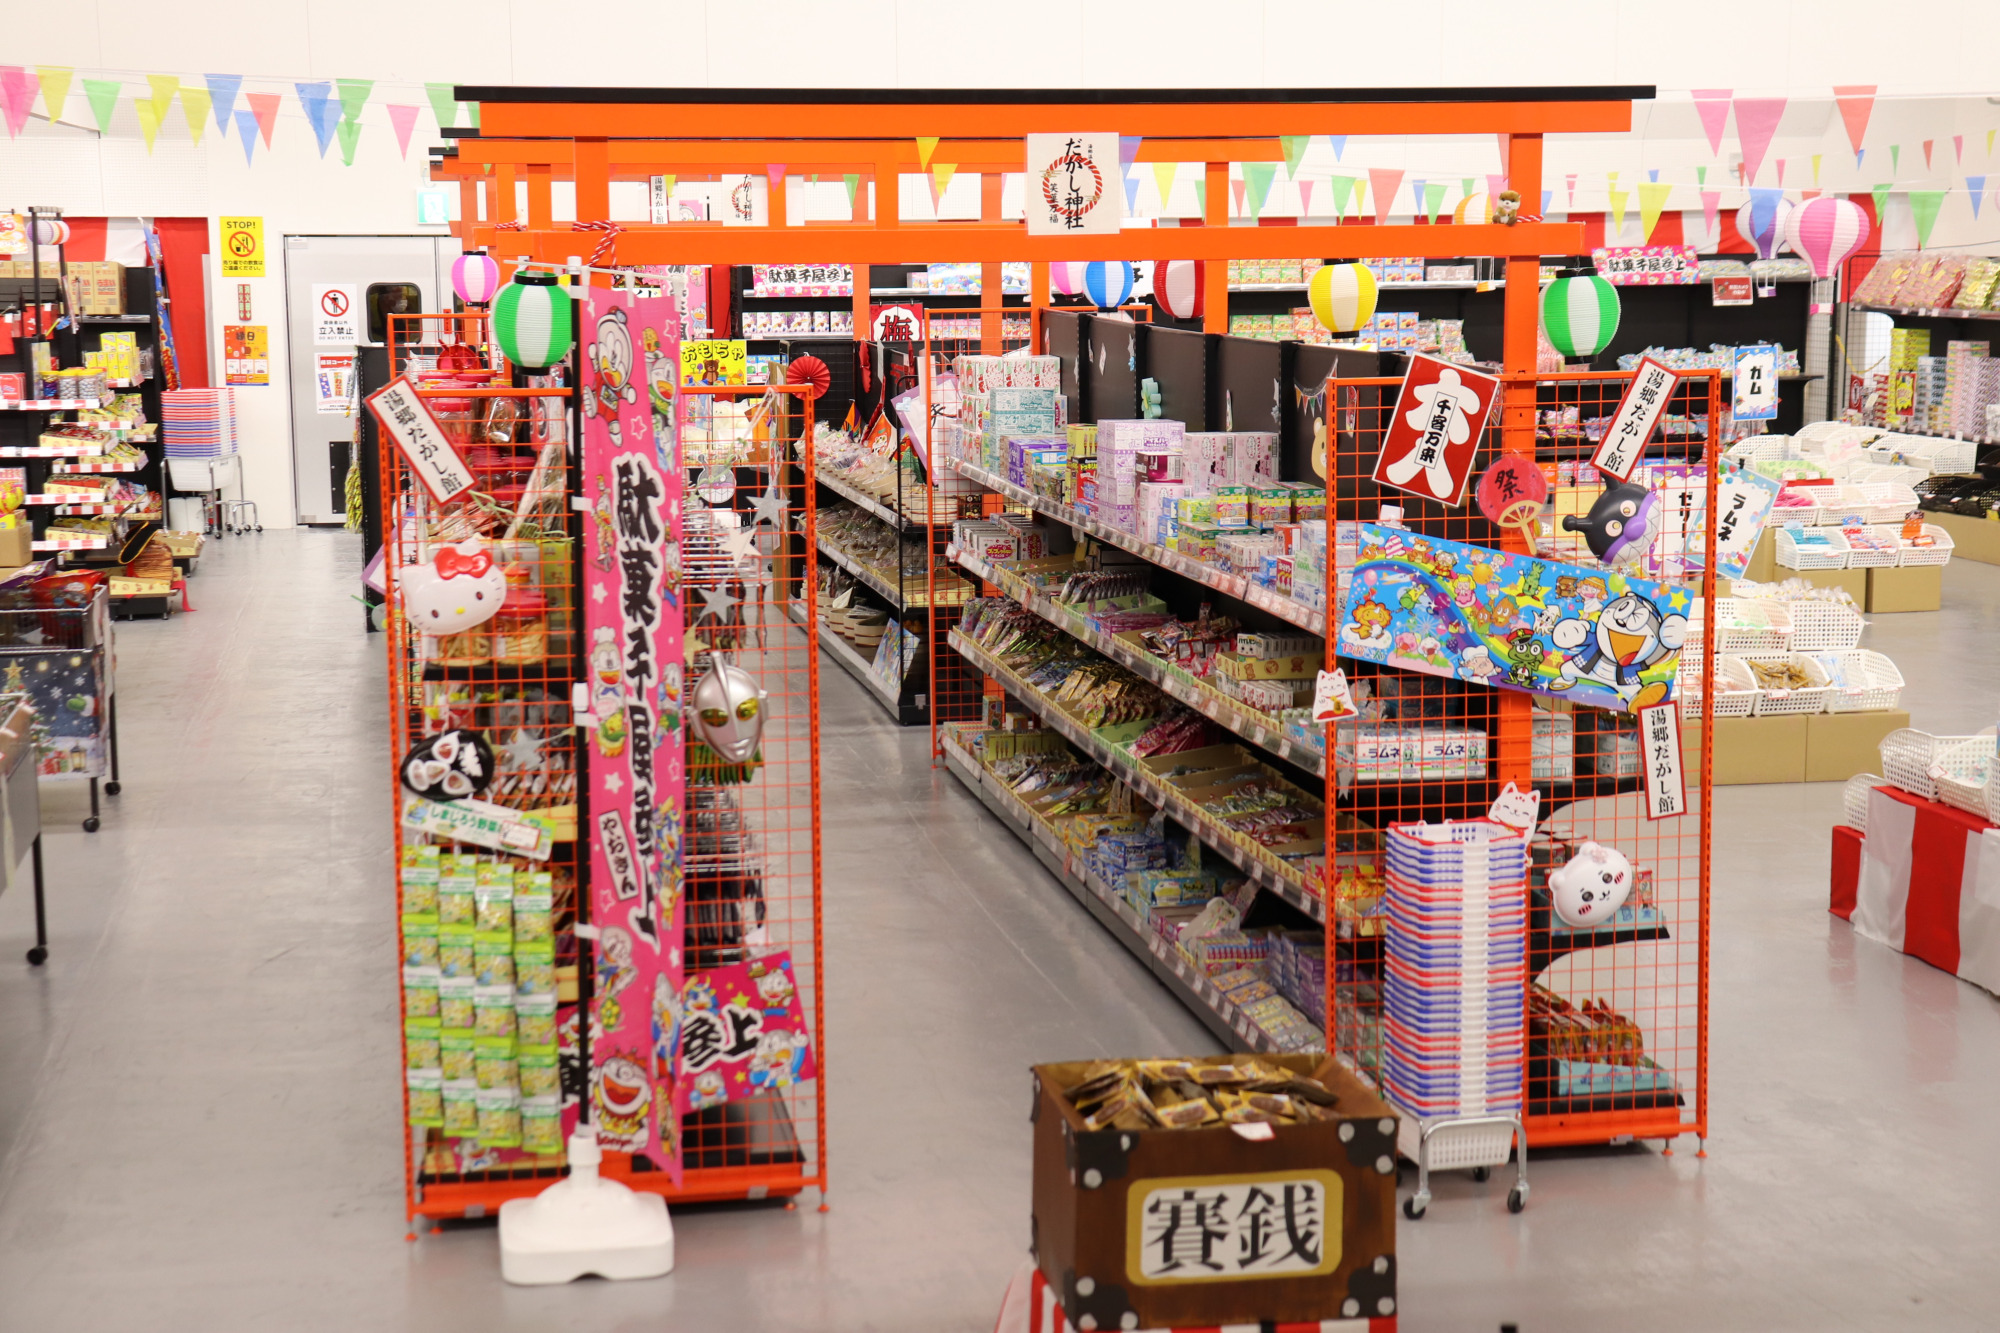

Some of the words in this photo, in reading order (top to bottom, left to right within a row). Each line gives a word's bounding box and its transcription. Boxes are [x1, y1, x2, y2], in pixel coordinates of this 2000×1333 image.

[1064, 138, 1084, 230] だがし神社
[226, 221, 256, 229] STOP!
[318, 327, 354, 335] 立入禁止
[681, 342, 745, 362] おもちゃ
[1750, 365, 1764, 395] ガム
[1419, 400, 1451, 463] 千客万来
[1604, 369, 1665, 472] 湯郷だがし館
[1495, 468, 1523, 502] 祭
[1678, 491, 1693, 539] ゼリー
[1718, 493, 1747, 541] ラムネ
[1368, 747, 1400, 759] ラムネ
[1434, 745, 1465, 756] ラムネ
[1651, 708, 1675, 814] 湯郷だがし館
[1144, 1183, 1321, 1276] 賽銭
